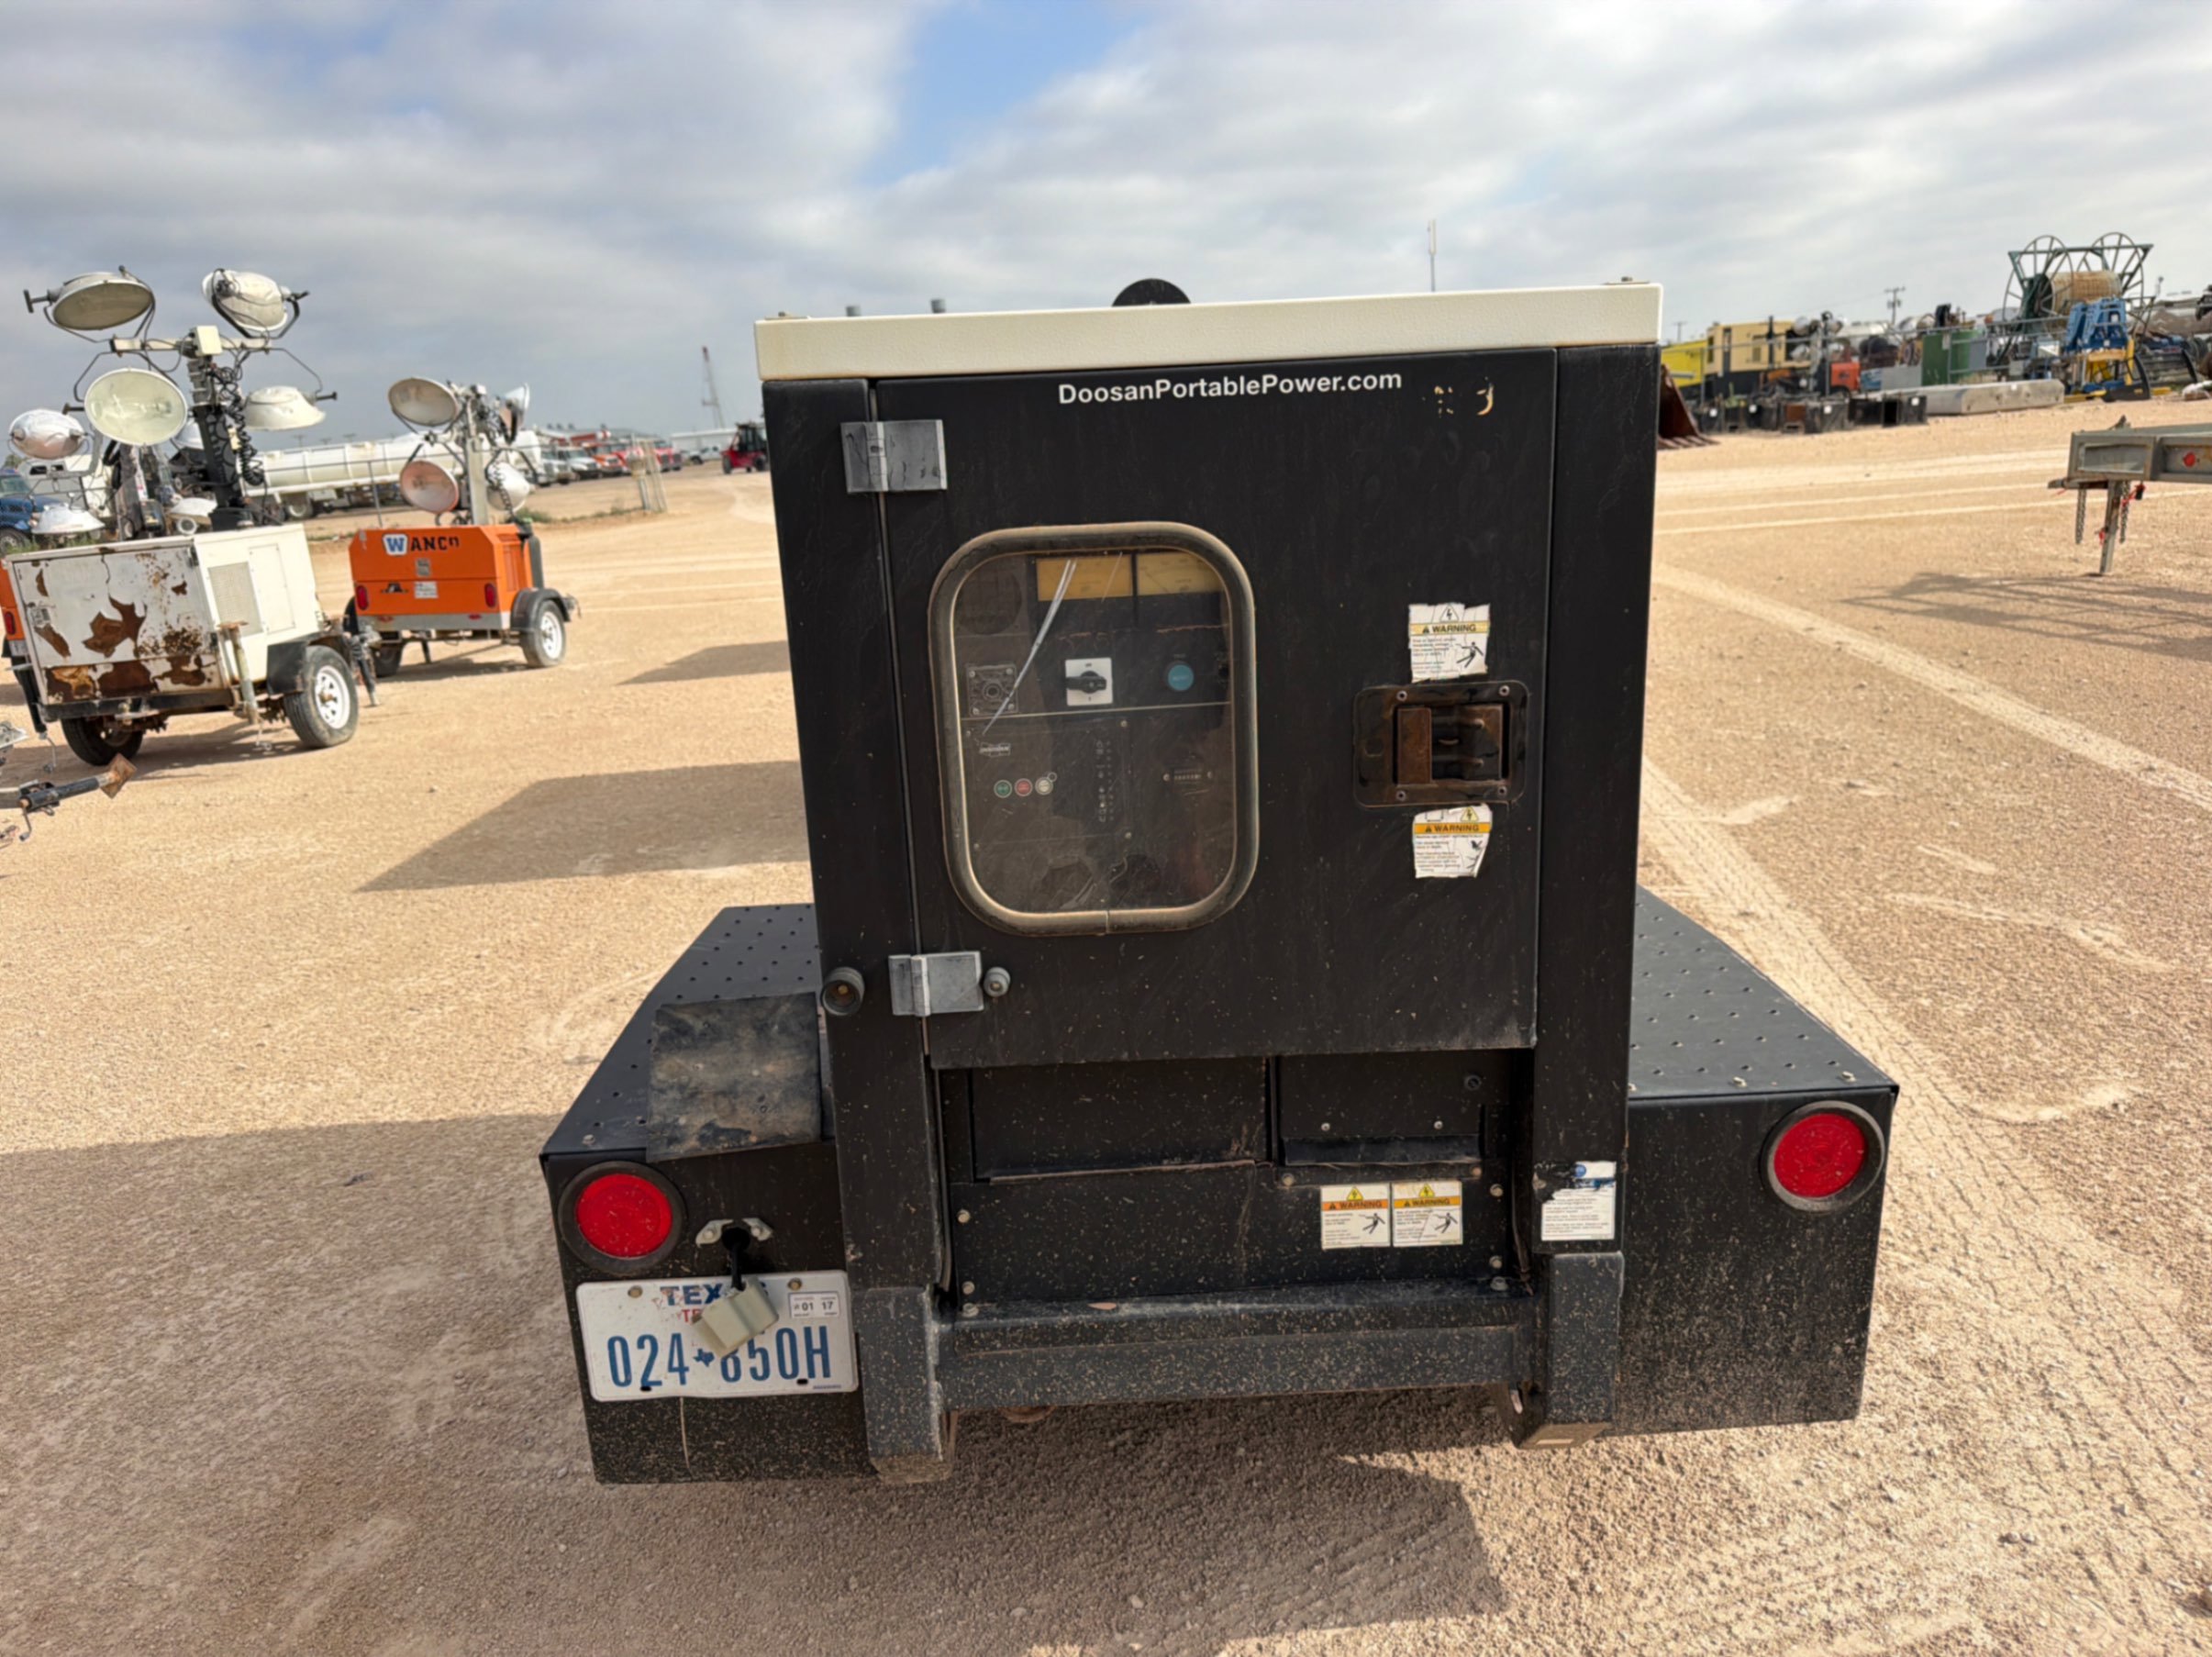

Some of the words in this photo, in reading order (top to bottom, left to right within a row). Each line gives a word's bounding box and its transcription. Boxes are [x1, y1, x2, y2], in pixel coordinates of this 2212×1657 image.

[1058, 373, 1402, 404] DoosanPortablePower.com
[1432, 623, 1476, 633] WARNING
[1435, 824, 1479, 832] WARNING
[1339, 1201, 1383, 1209] WARNING
[1413, 1198, 1451, 1207] WARNING
[606, 1332, 689, 1387] 024
